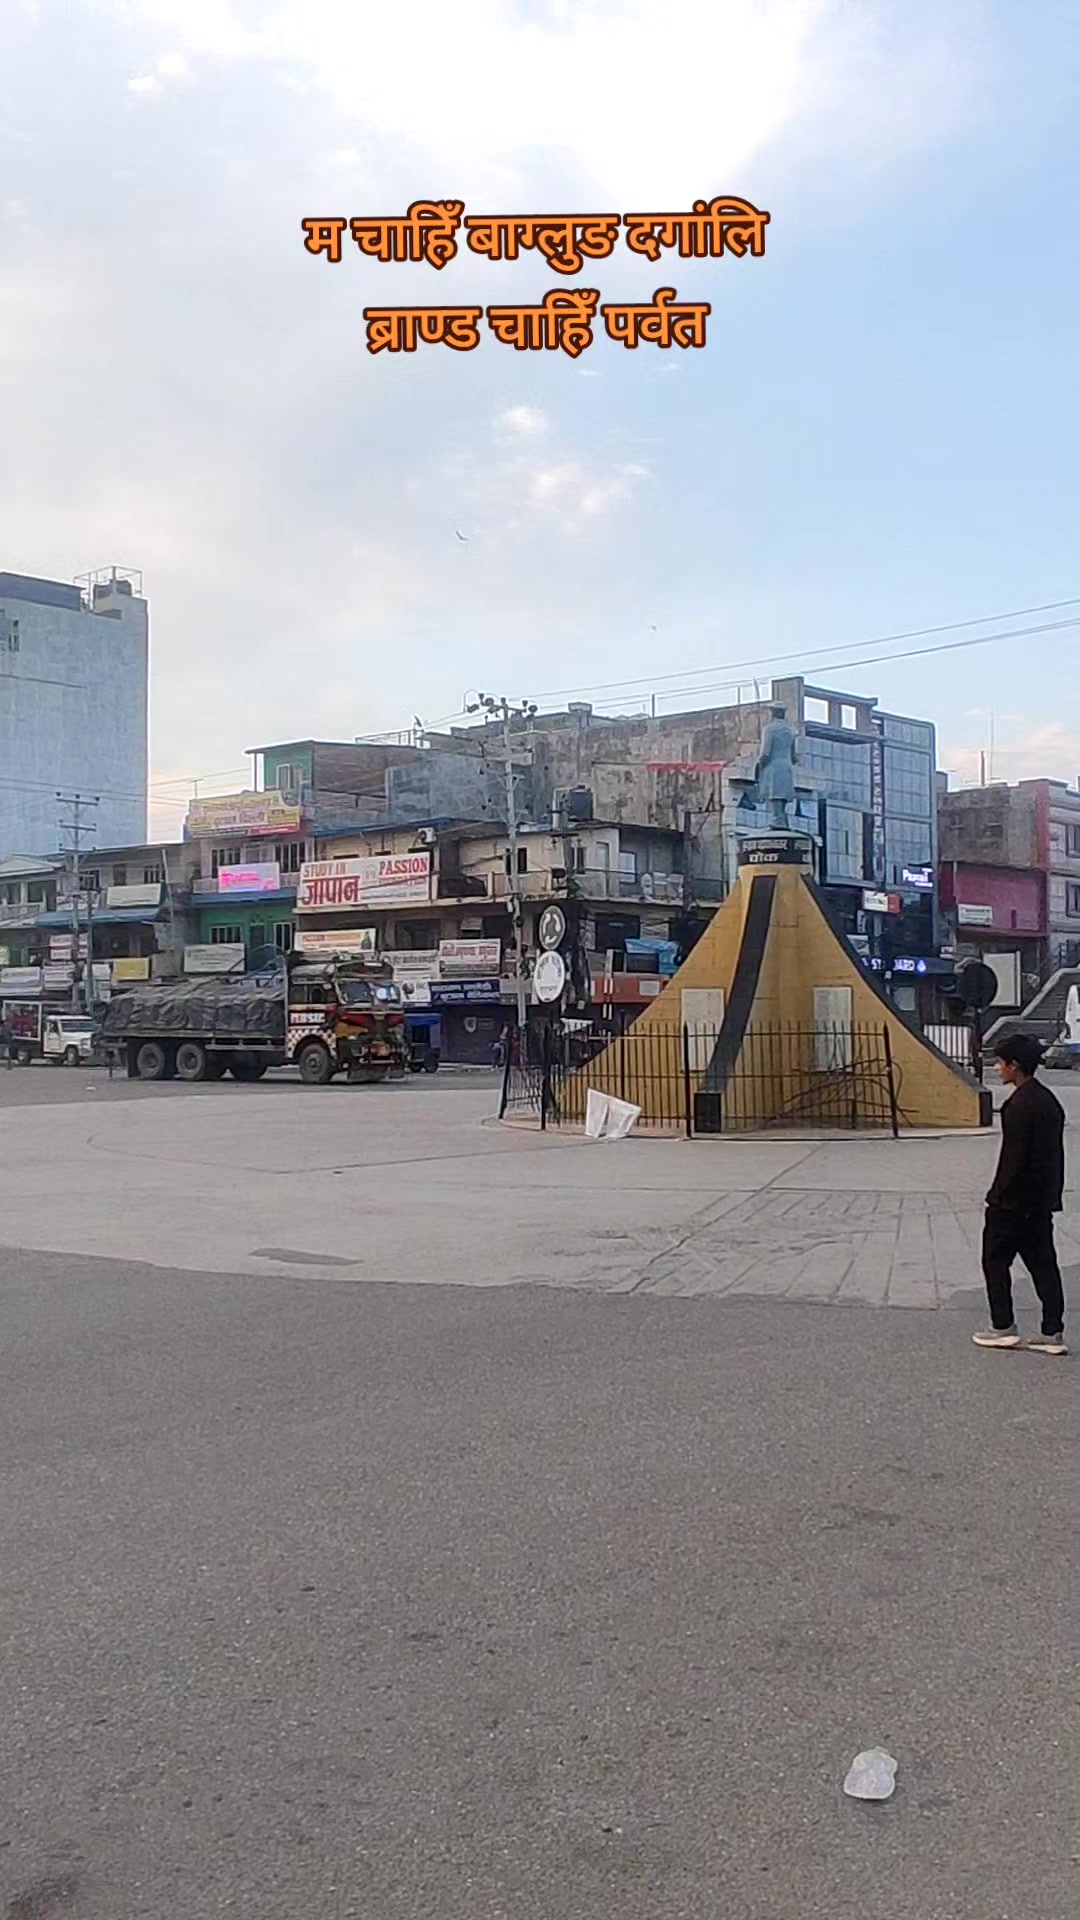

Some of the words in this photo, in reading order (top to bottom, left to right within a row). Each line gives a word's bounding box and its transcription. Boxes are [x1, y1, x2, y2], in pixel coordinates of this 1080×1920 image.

[303, 864, 333, 878] STUDY
[335, 863, 346, 875] IN
[379, 857, 427, 876] PASSION
[302, 876, 360, 905] जापान
